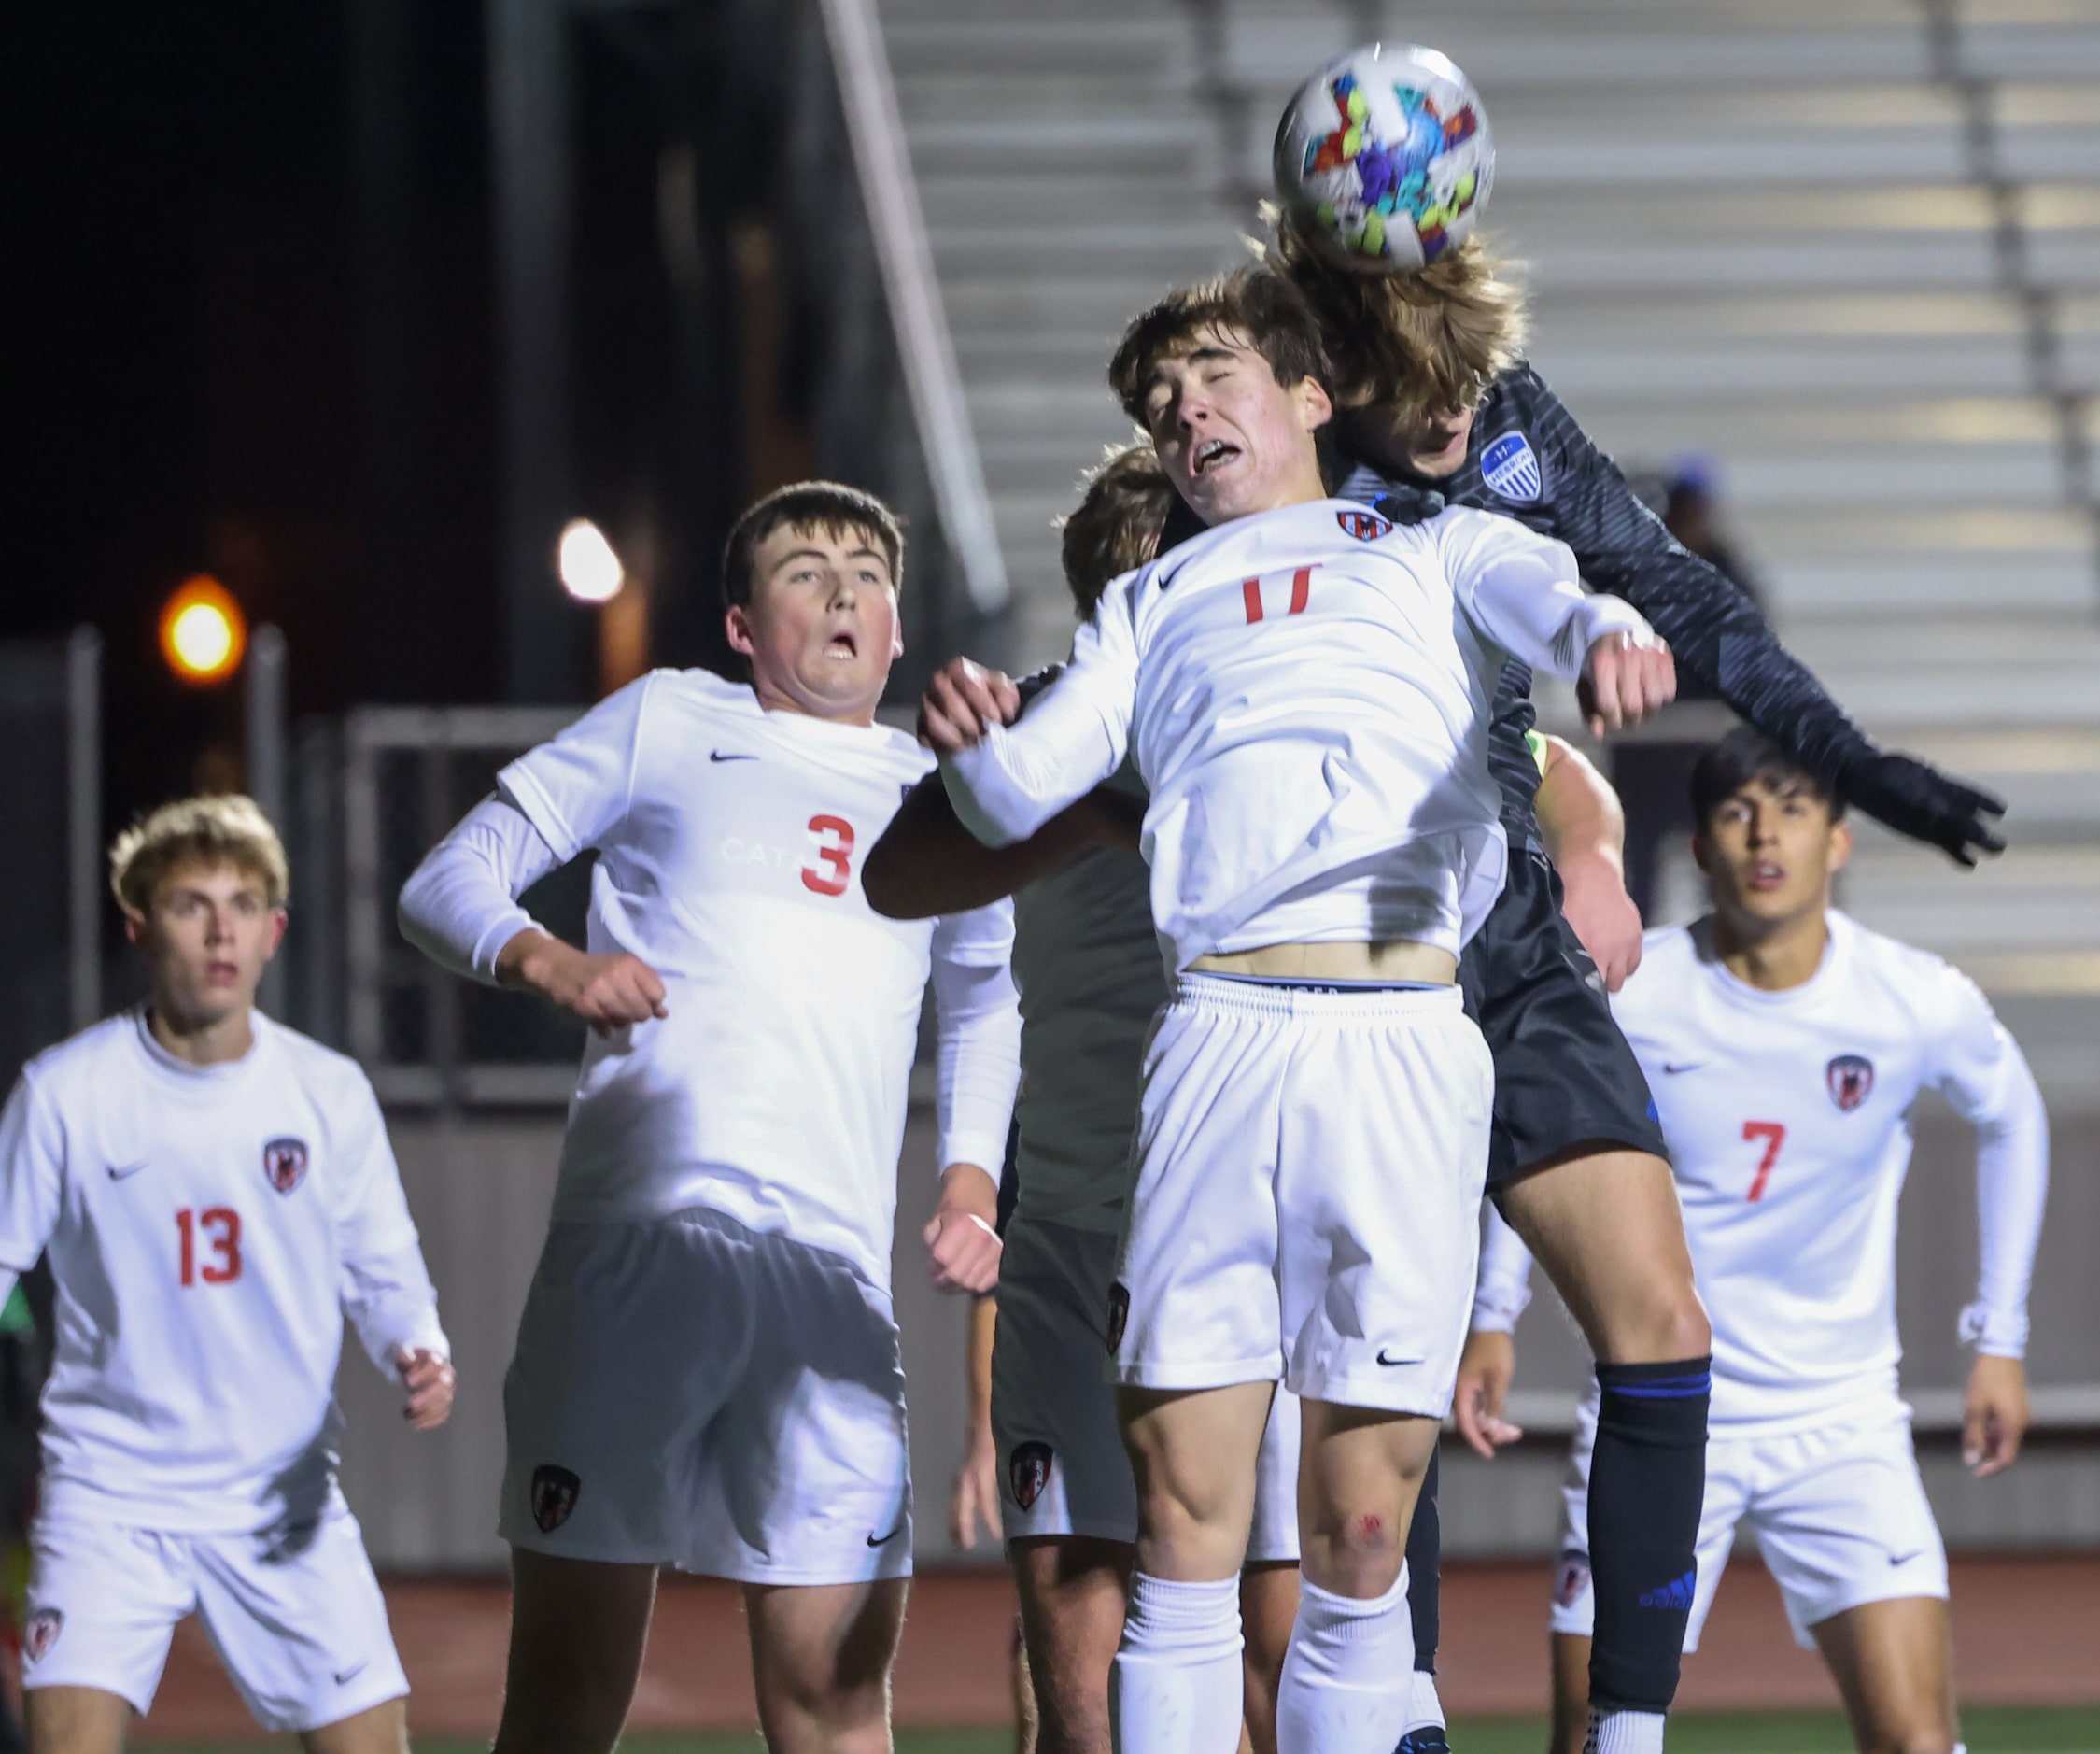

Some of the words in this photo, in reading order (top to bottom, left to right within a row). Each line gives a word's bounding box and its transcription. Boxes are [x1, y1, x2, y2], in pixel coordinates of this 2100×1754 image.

[801, 813, 854, 897] 3
[1742, 1121, 1785, 1203] 7
[176, 1207, 242, 1289] 13
